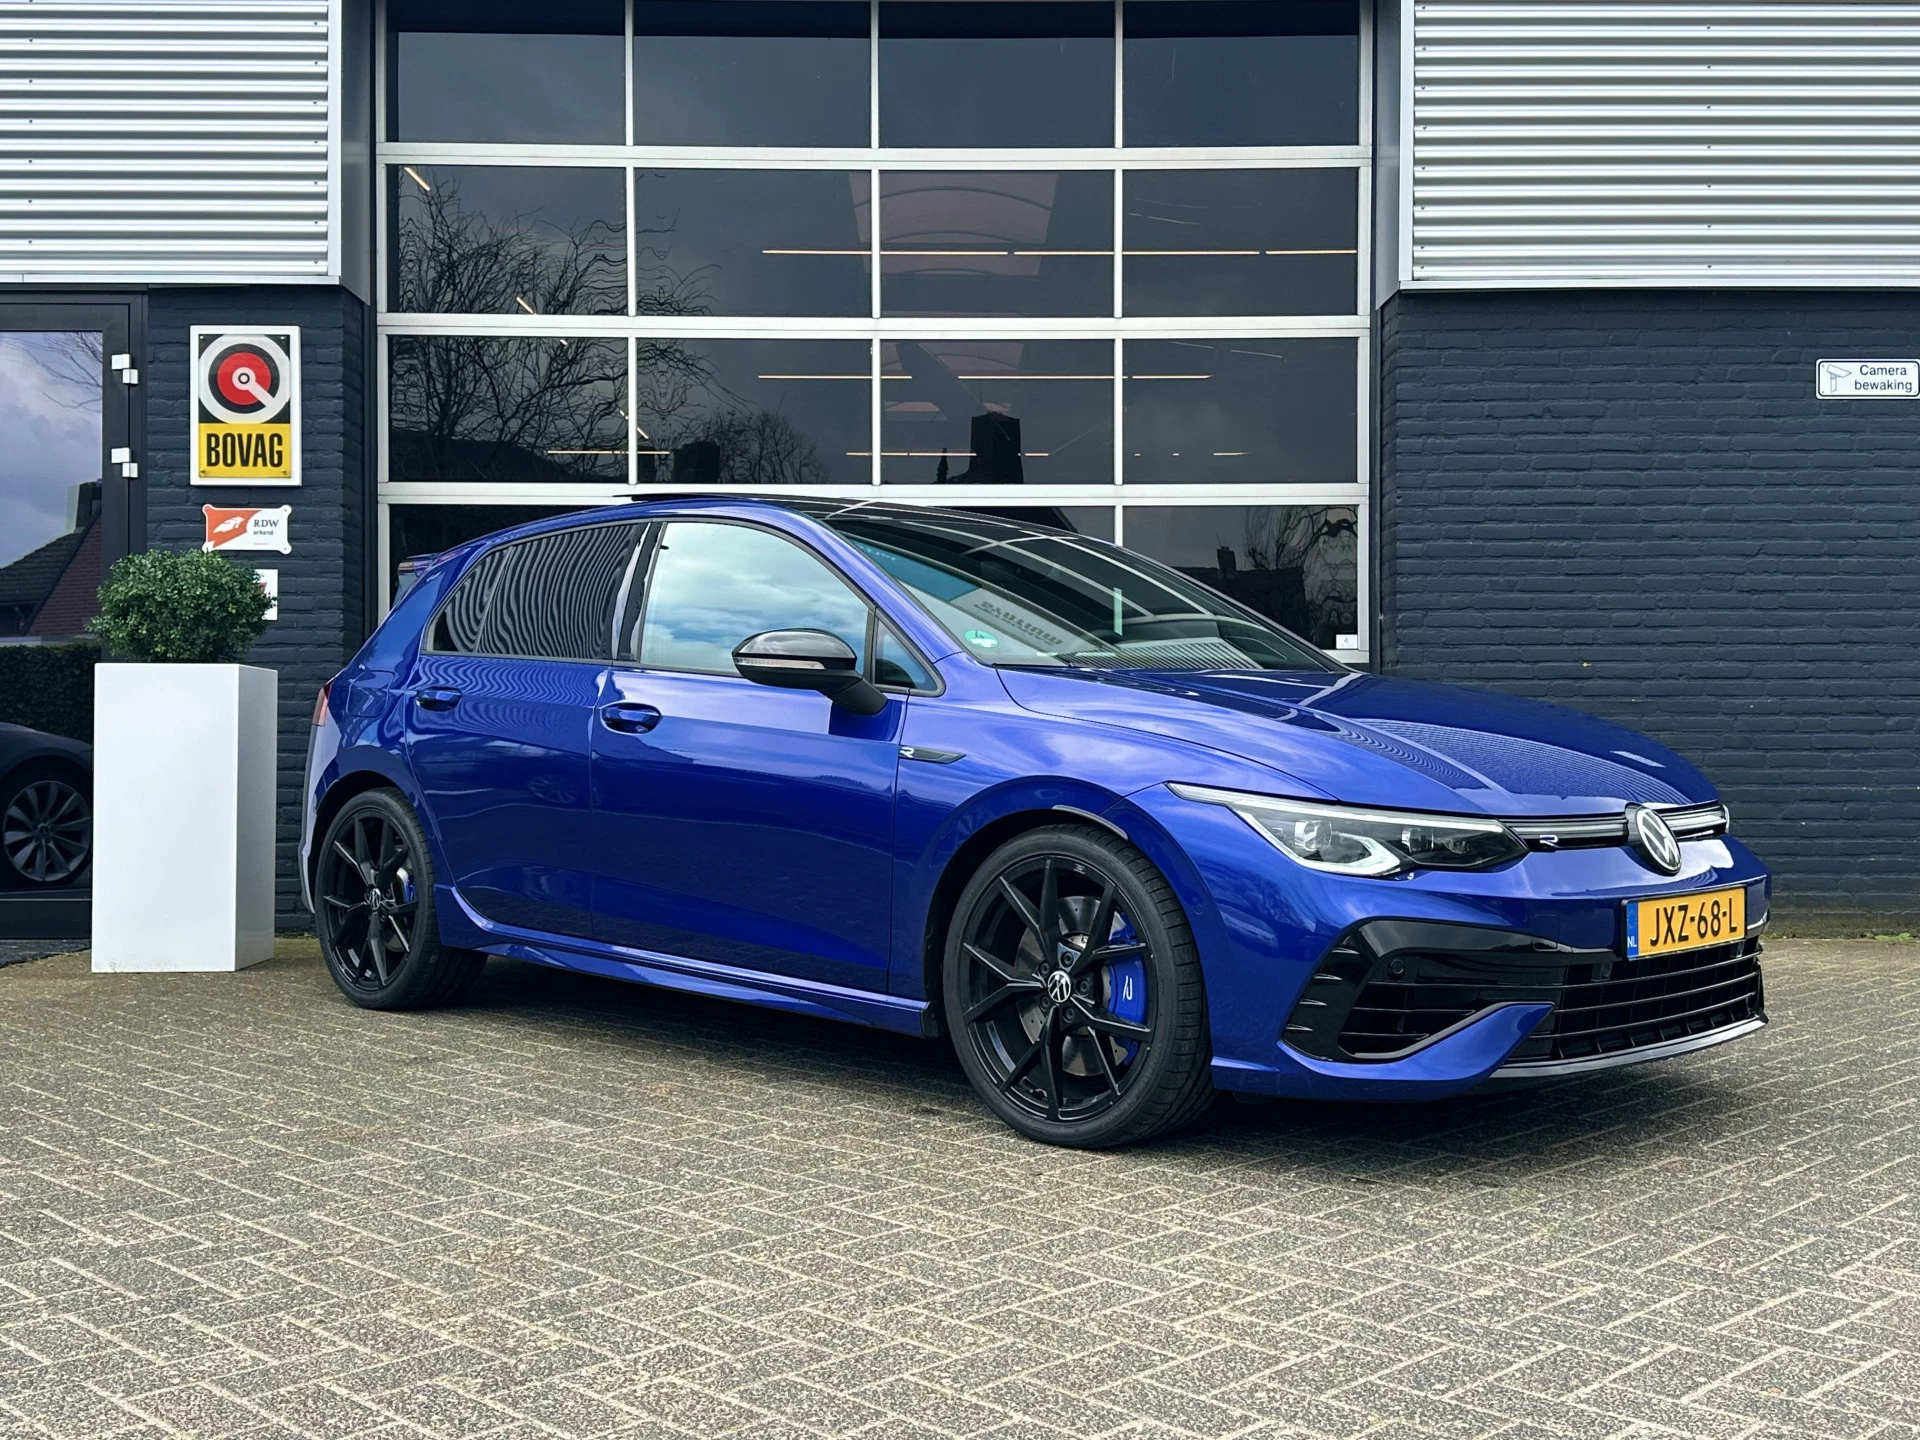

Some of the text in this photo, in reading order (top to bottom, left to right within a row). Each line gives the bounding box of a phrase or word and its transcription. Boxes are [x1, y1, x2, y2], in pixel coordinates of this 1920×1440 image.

[1859, 364, 1907, 376] Camera
[1854, 379, 1913, 393] bewaking
[206, 432, 283, 468] BOVAG
[253, 519, 280, 528] RDW
[899, 746, 915, 758] R
[1539, 834, 1560, 849] R
[1649, 897, 1738, 947] JXZ-68-L
[1627, 935, 1637, 947] NL
